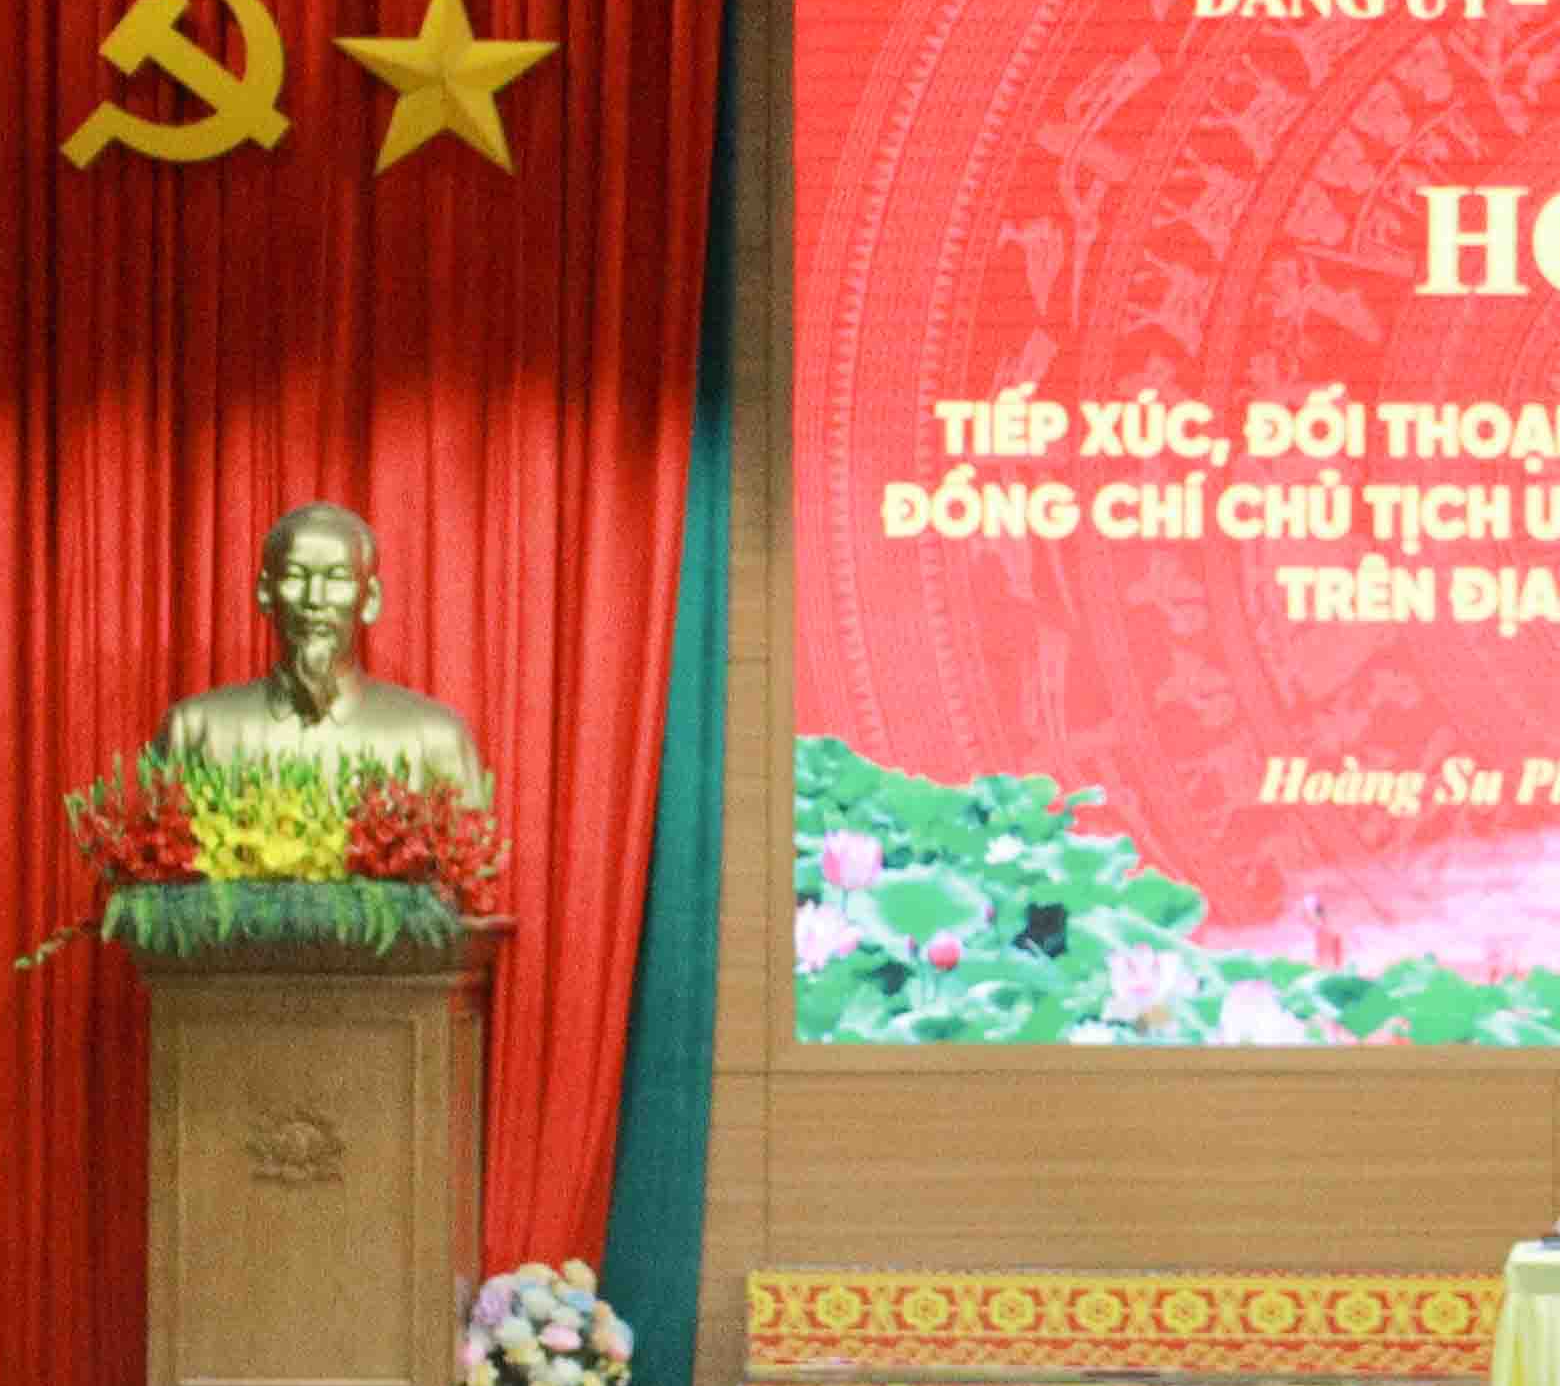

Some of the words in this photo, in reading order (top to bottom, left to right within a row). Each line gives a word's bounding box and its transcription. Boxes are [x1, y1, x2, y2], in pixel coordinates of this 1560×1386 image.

[936, 383, 1067, 455] TIẾP
[1082, 390, 1229, 465] XÚC,
[1245, 384, 1364, 458] ĐỐI
[1093, 472, 1205, 538] CHÍ
[1217, 469, 1350, 539] CHỦ
[1364, 486, 1510, 554] TỊCH
[1276, 554, 1435, 621] TRÊN
[1260, 757, 1424, 814] Hoàng
[1435, 759, 1502, 805] Su
